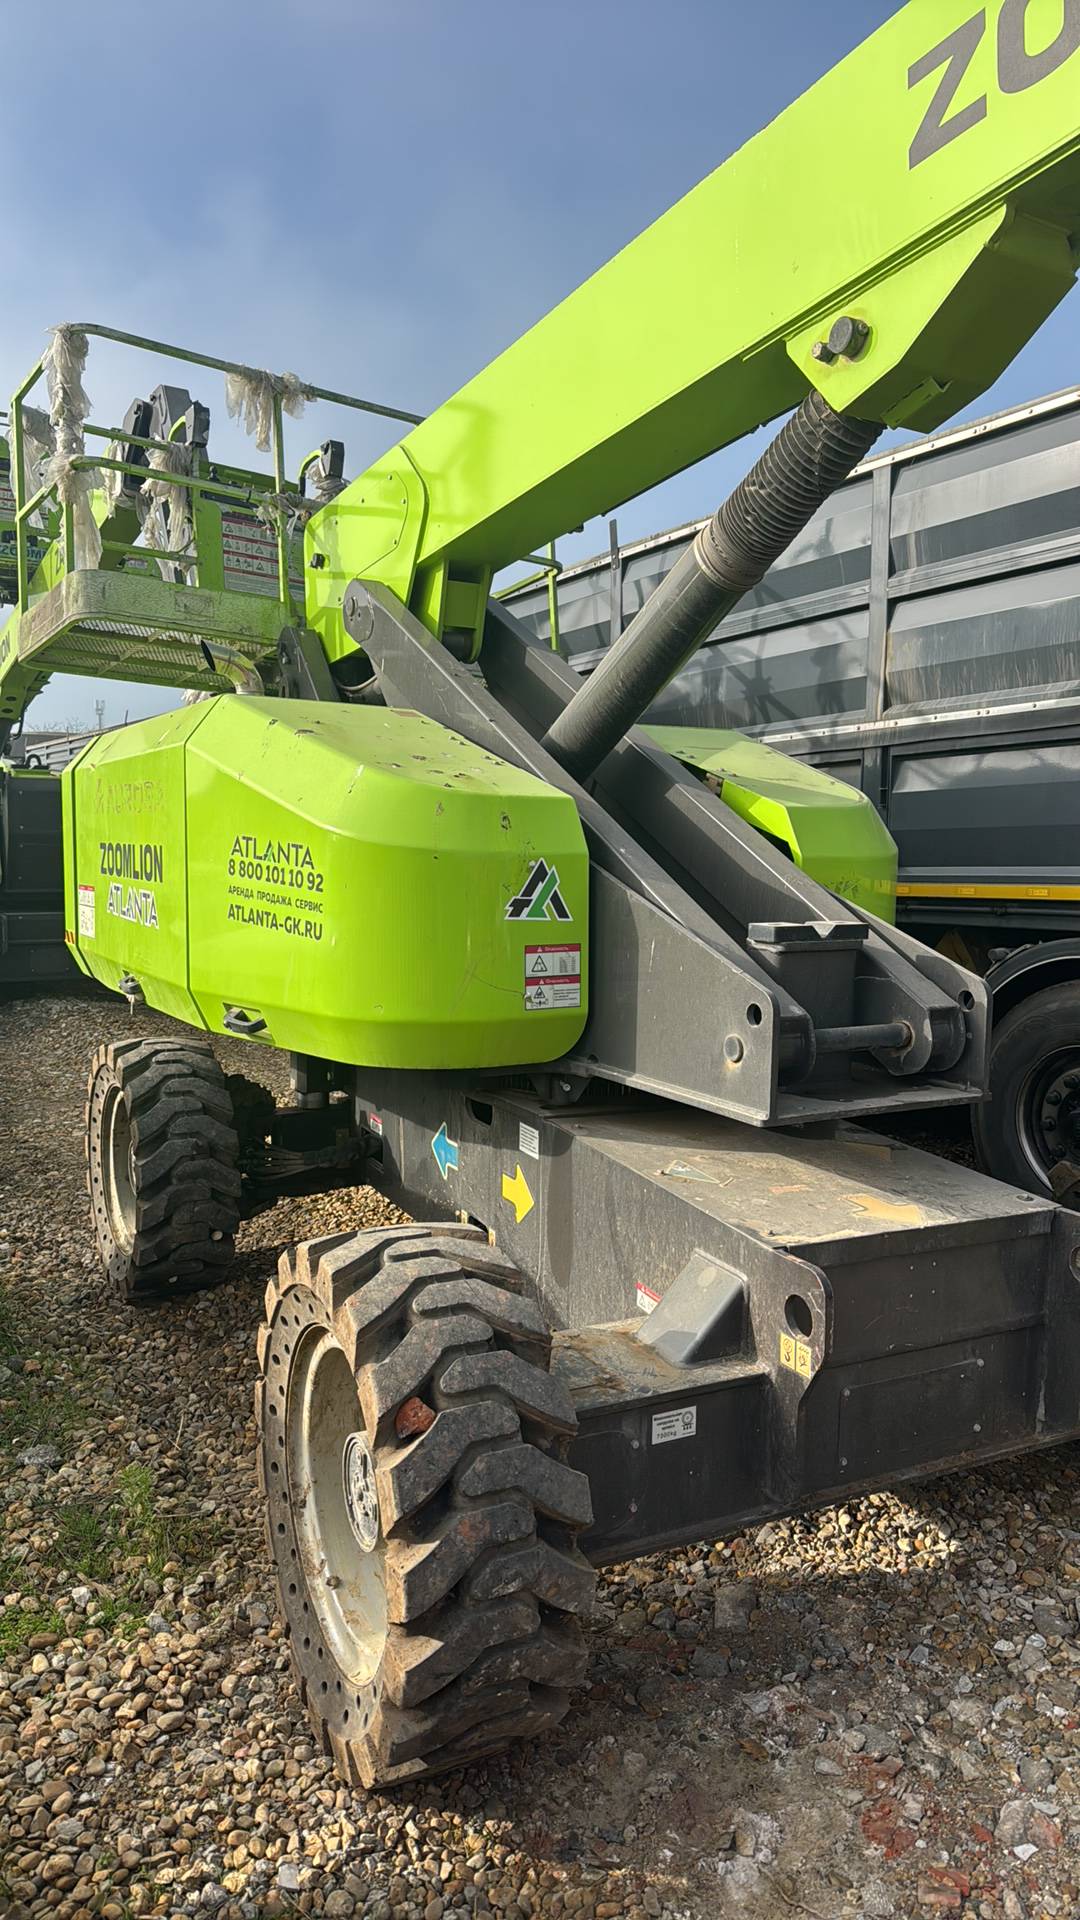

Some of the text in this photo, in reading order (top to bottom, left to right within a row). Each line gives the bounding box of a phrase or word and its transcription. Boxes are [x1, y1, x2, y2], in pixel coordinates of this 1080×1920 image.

[100, 842, 163, 883] ZOOMLION
[231, 835, 315, 870] ATLANTA
[228, 858, 324, 893] 8 800 101 10 92
[107, 882, 160, 929] ATLANTA
[228, 885, 323, 914] АРЕНДА ПРОДАЖА СЕРВИС
[228, 903, 323, 941] ATLANTA-GK.RU
